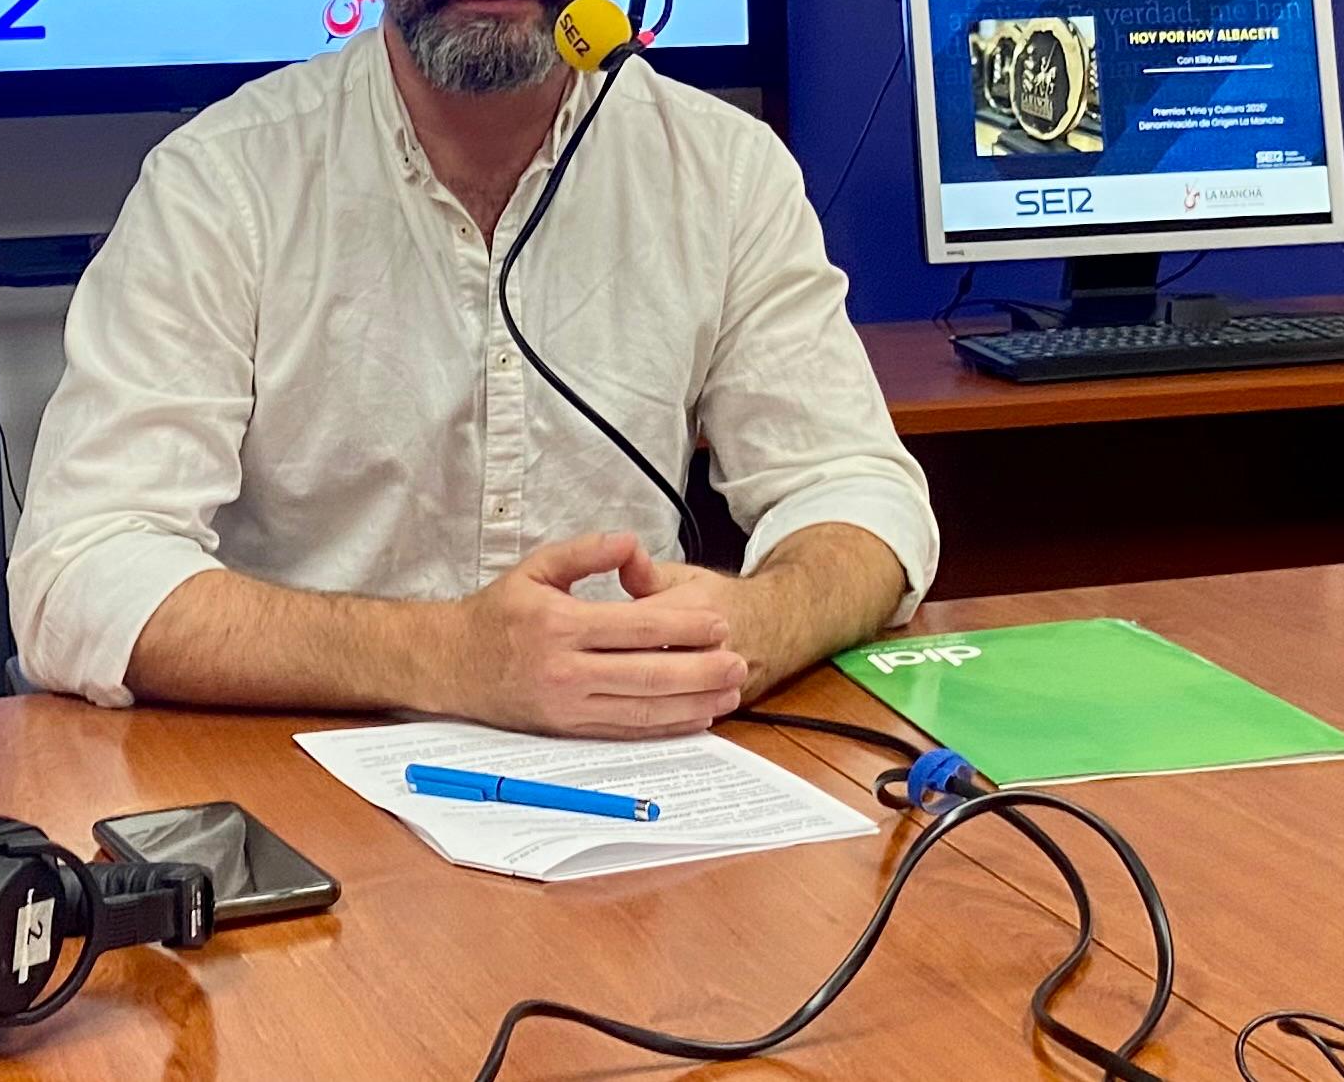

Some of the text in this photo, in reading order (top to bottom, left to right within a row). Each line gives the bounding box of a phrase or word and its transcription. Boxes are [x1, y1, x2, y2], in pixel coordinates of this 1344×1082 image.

[559, 13, 590, 58] SER
[1129, 27, 1279, 45] HOY POR HOY ALBACETE
[1015, 186, 1094, 217] SER
[27, 920, 43, 946] 2
